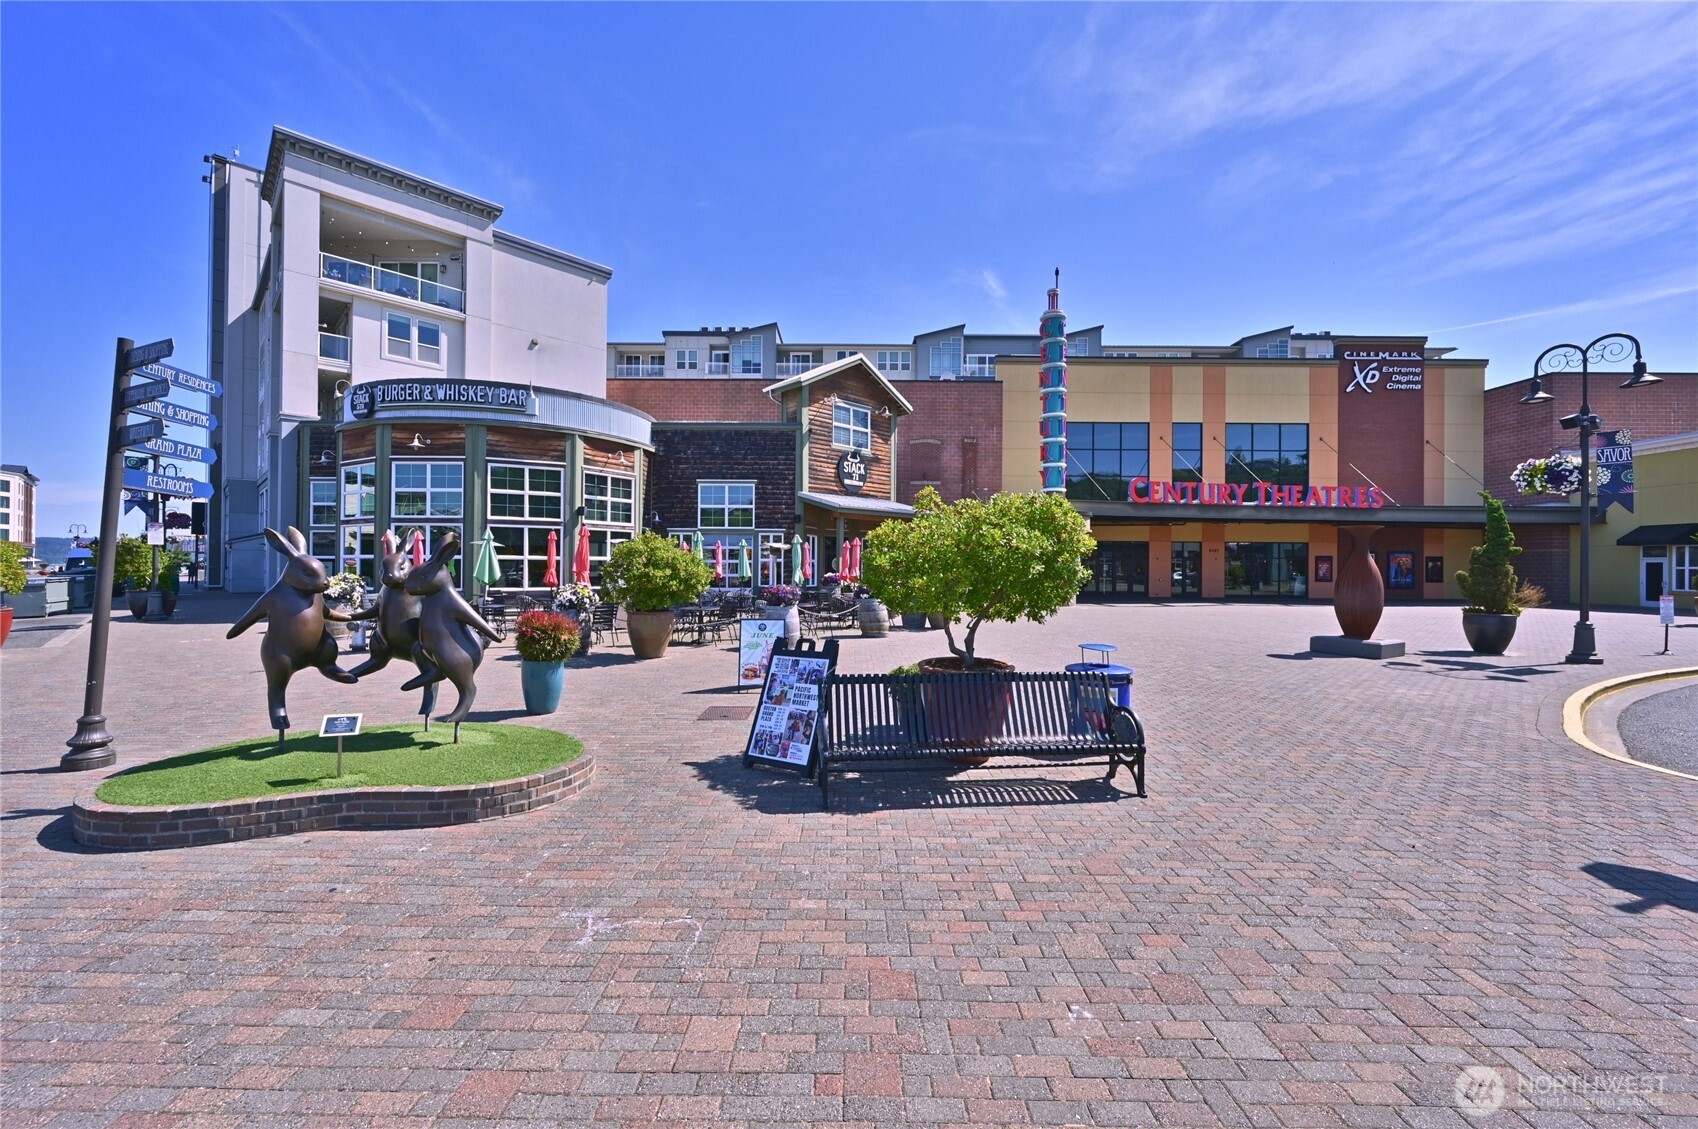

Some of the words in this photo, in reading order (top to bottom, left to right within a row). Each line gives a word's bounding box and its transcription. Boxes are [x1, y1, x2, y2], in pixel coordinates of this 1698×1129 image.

[1344, 351, 1422, 360] CINEMARK
[142, 363, 176, 381] CENTURY
[178, 372, 216, 394] RESIDENCES
[1345, 360, 1380, 393] XD
[1391, 374, 1422, 382] Digital
[1386, 382, 1421, 390] Cinema
[353, 393, 370, 405] STACK
[377, 383, 421, 402] BURGER
[423, 384, 433, 400] &
[436, 383, 495, 403] WHISKEY
[500, 387, 526, 406] BAR
[167, 405, 175, 417] &
[175, 407, 210, 427] SHOPPING
[145, 438, 175, 453] GRAND
[177, 443, 202, 460] PLAZA
[1597, 447, 1632, 463] SAVOR
[843, 461, 865, 475] STACK
[146, 475, 194, 494] RESTROOMS
[1128, 477, 1249, 504] CENTURY
[1253, 481, 1385, 508] THEATRES
[795, 685, 811, 694] PACIFIC
[791, 698, 810, 707] MARKET
